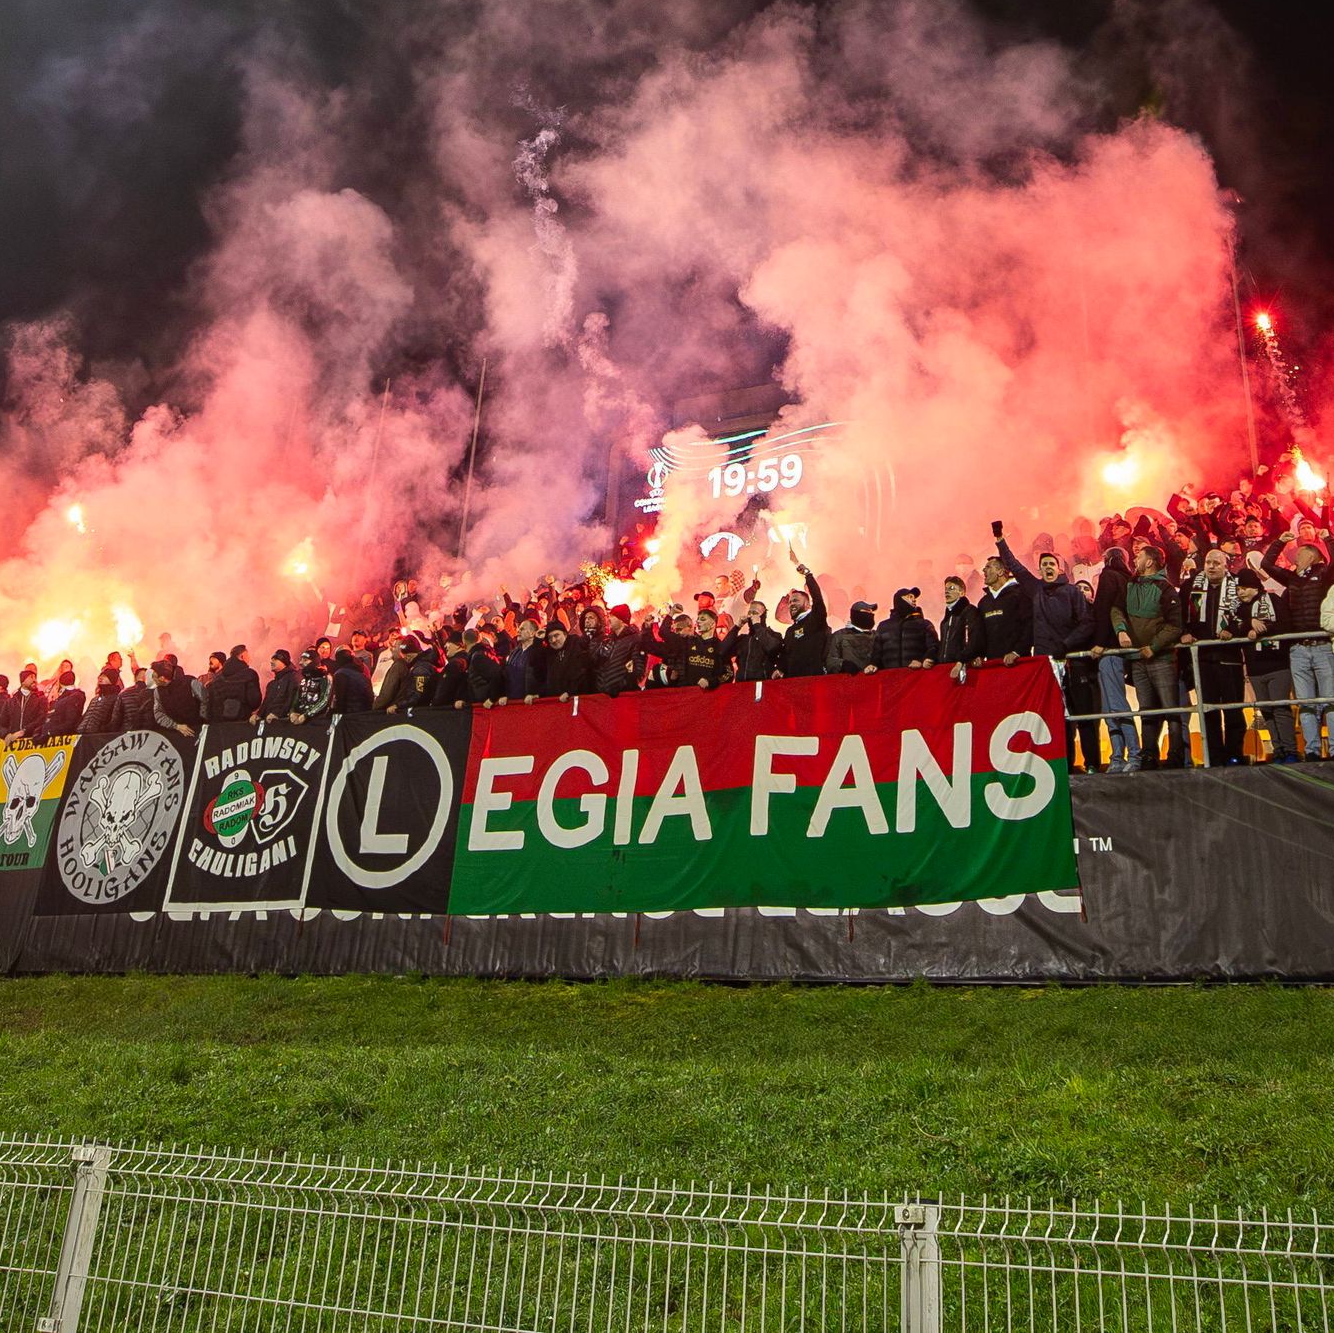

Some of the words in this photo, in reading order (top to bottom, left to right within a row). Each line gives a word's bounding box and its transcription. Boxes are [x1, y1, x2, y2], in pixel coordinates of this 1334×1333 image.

[708, 454, 803, 499] 19:59
[416, 676, 425, 693] EA7
[204, 736, 321, 779] RADOMSCY
[65, 732, 150, 820] WARSAW
[153, 741, 181, 812] FANS
[359, 755, 409, 854] L
[468, 745, 713, 851] EGIA
[750, 711, 1055, 838] FANS
[213, 796, 256, 819] RADOMIAK
[227, 786, 244, 800] RKS
[219, 813, 249, 833] RADOM
[0, 852, 30, 866] TOUR
[188, 835, 297, 878] CHULIGANI
[1088, 837, 1113, 852] TM
[59, 831, 167, 899] HOOLIGANS
